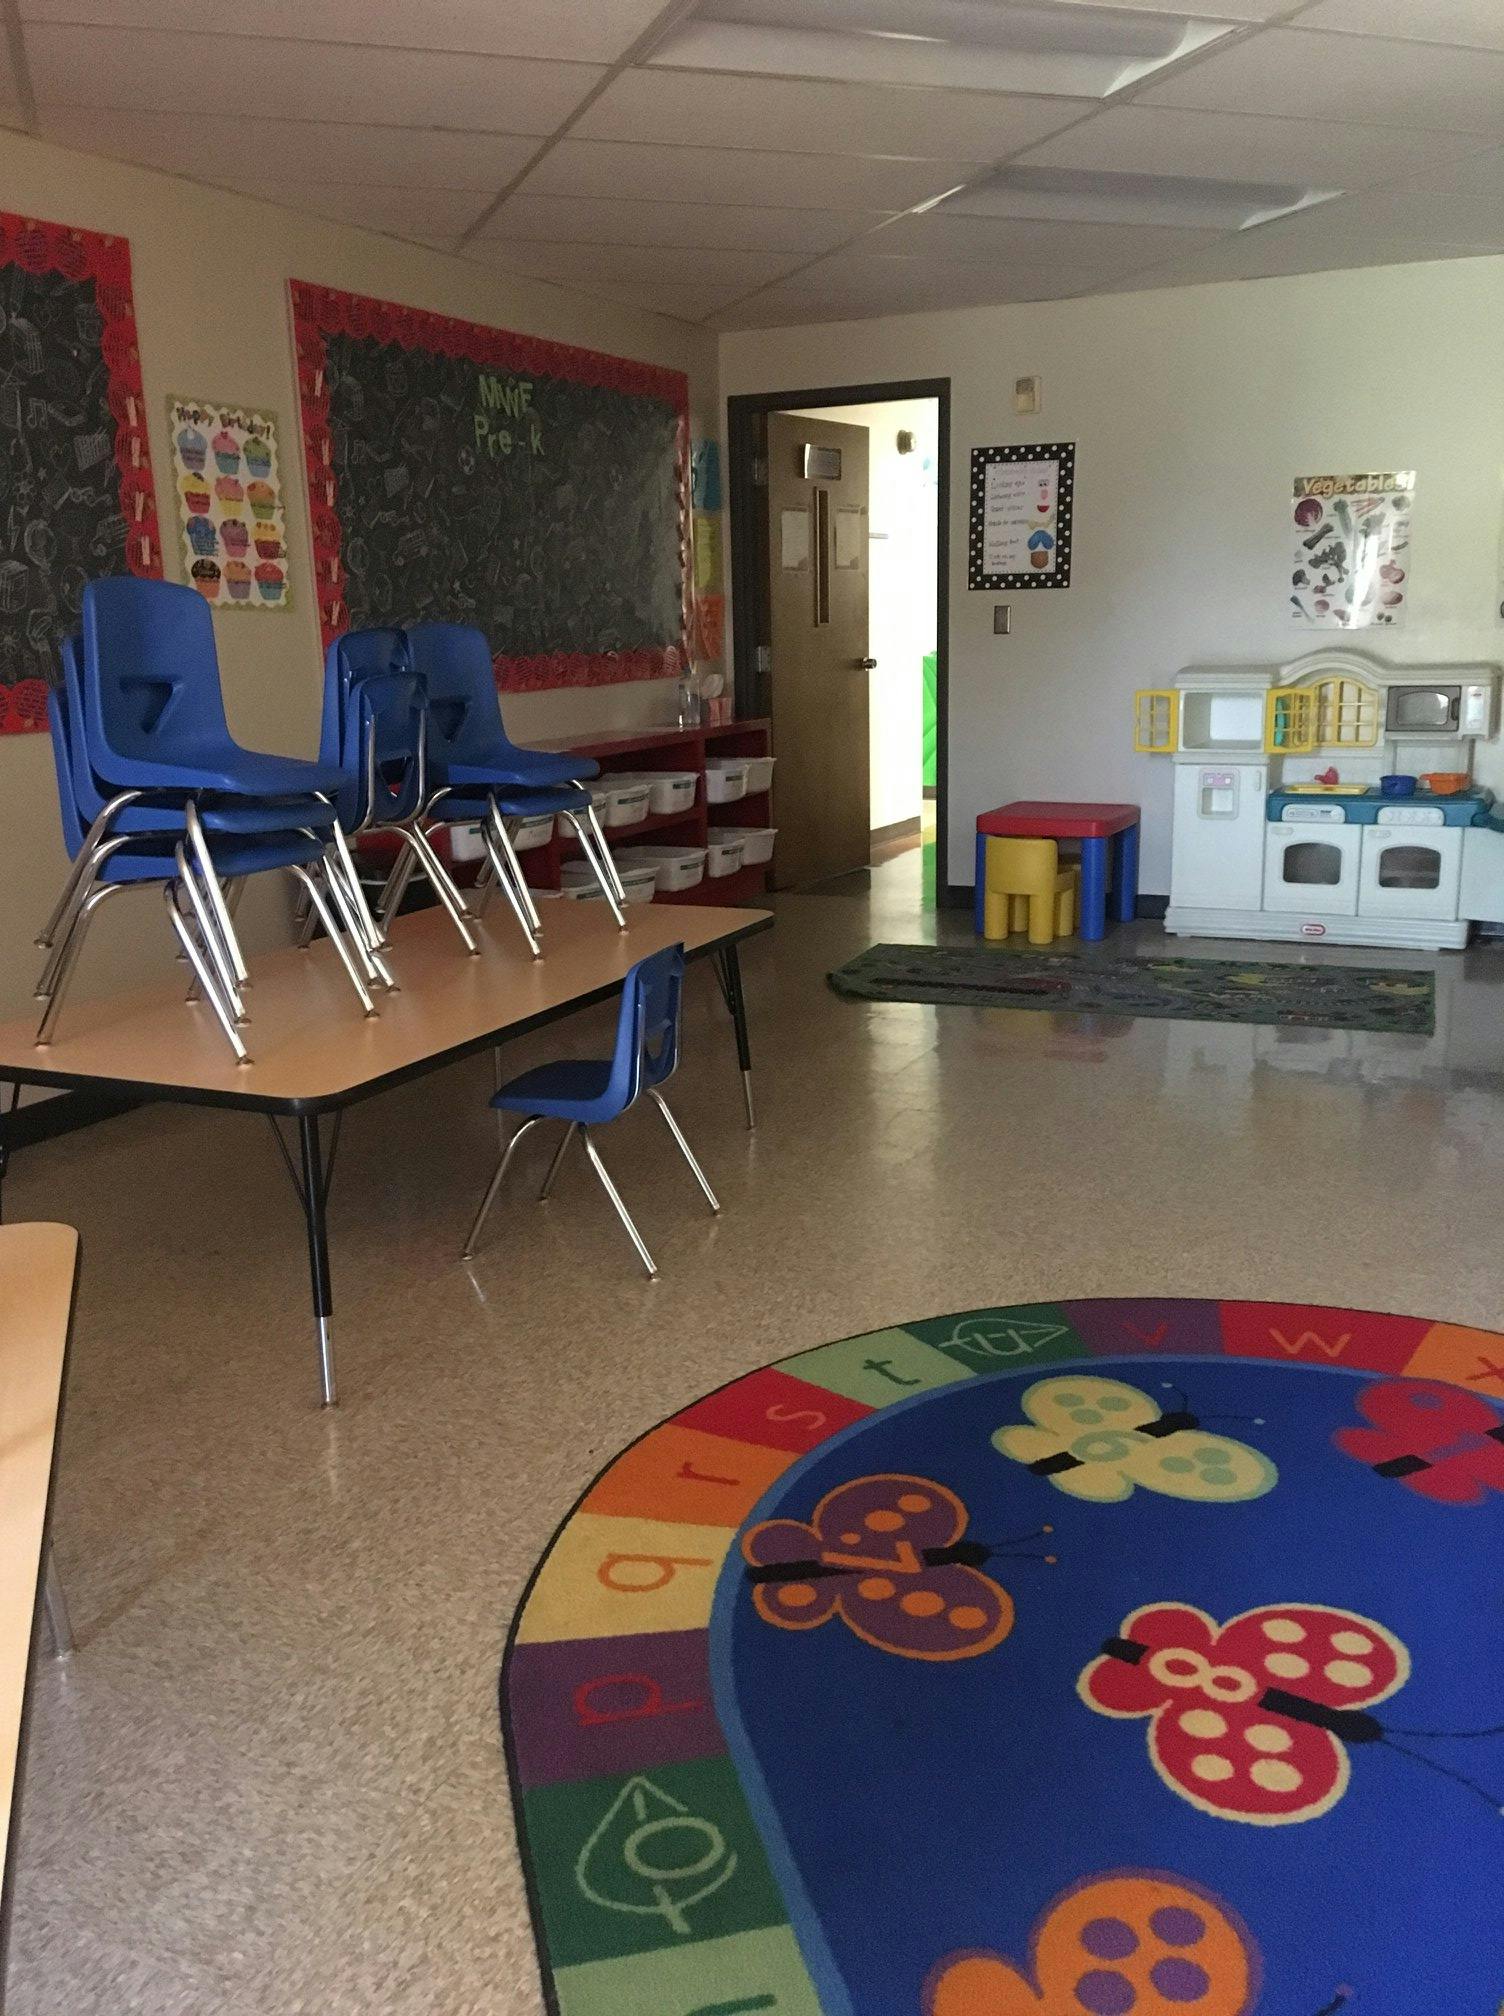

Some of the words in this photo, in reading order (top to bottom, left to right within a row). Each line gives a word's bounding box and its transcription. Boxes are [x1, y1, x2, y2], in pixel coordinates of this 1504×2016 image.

[1120, 1321, 1168, 1346] v
[1269, 1327, 1351, 1357] w
[862, 1358, 922, 1387] t
[765, 1404, 826, 1430] s
[677, 1461, 741, 1487] r
[1149, 1647, 1257, 1703] 8
